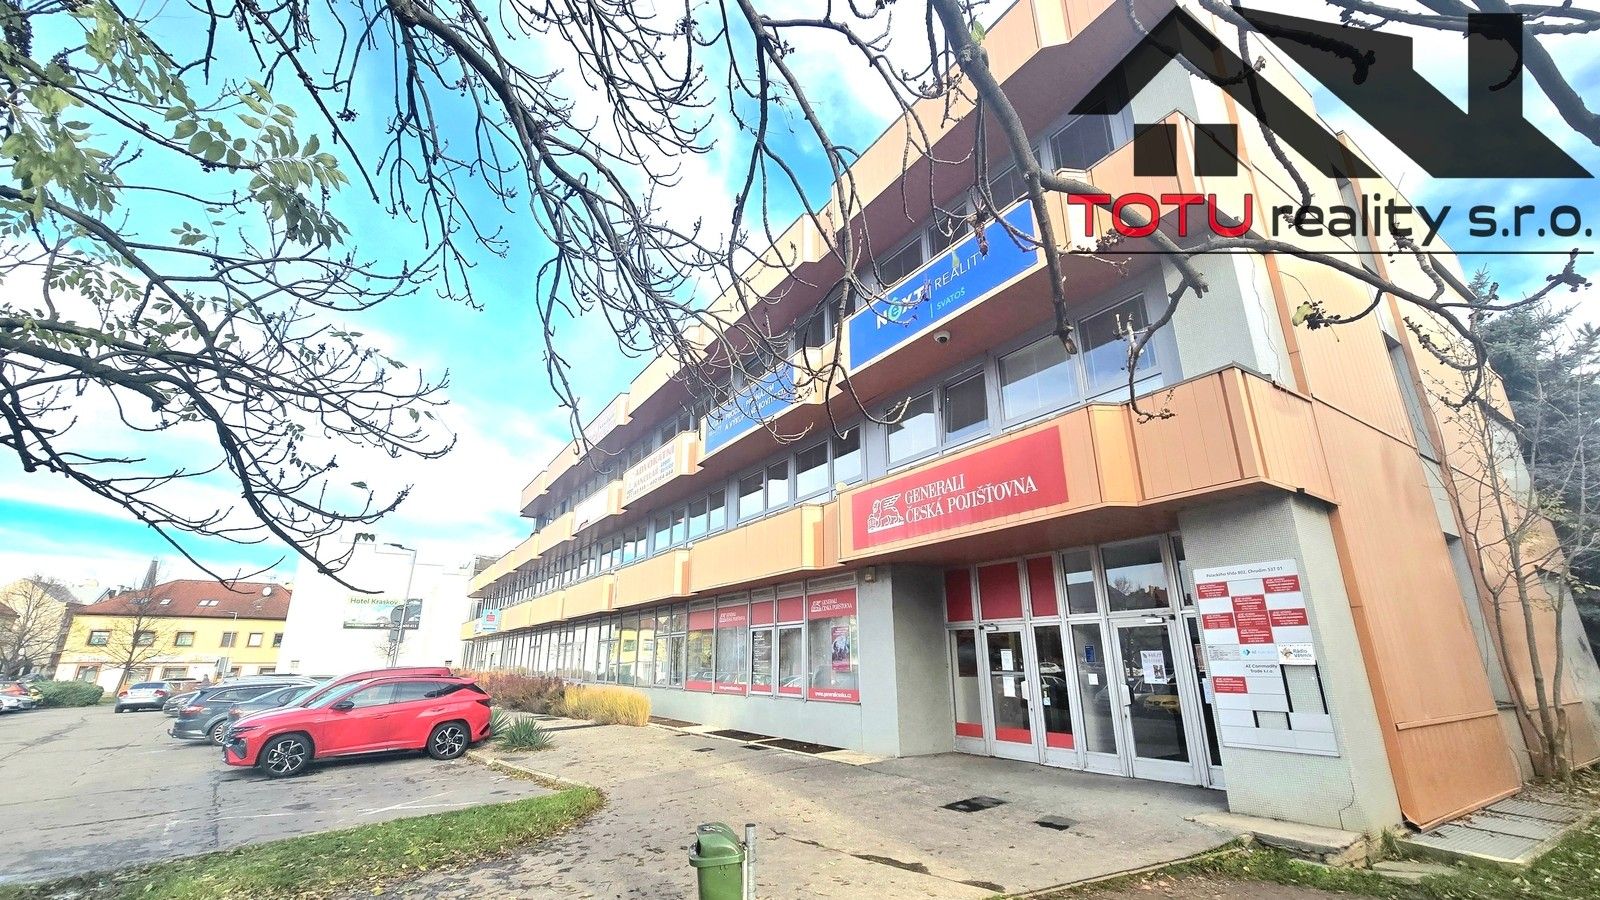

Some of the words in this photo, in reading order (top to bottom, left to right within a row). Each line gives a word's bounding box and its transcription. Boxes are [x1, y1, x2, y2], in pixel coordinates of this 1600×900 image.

[934, 250, 988, 291] REALIT
[904, 473, 965, 504] GENERALI
[905, 496, 944, 524] ČESKÁ
[947, 475, 1038, 513] POJIŠŤOVNA
